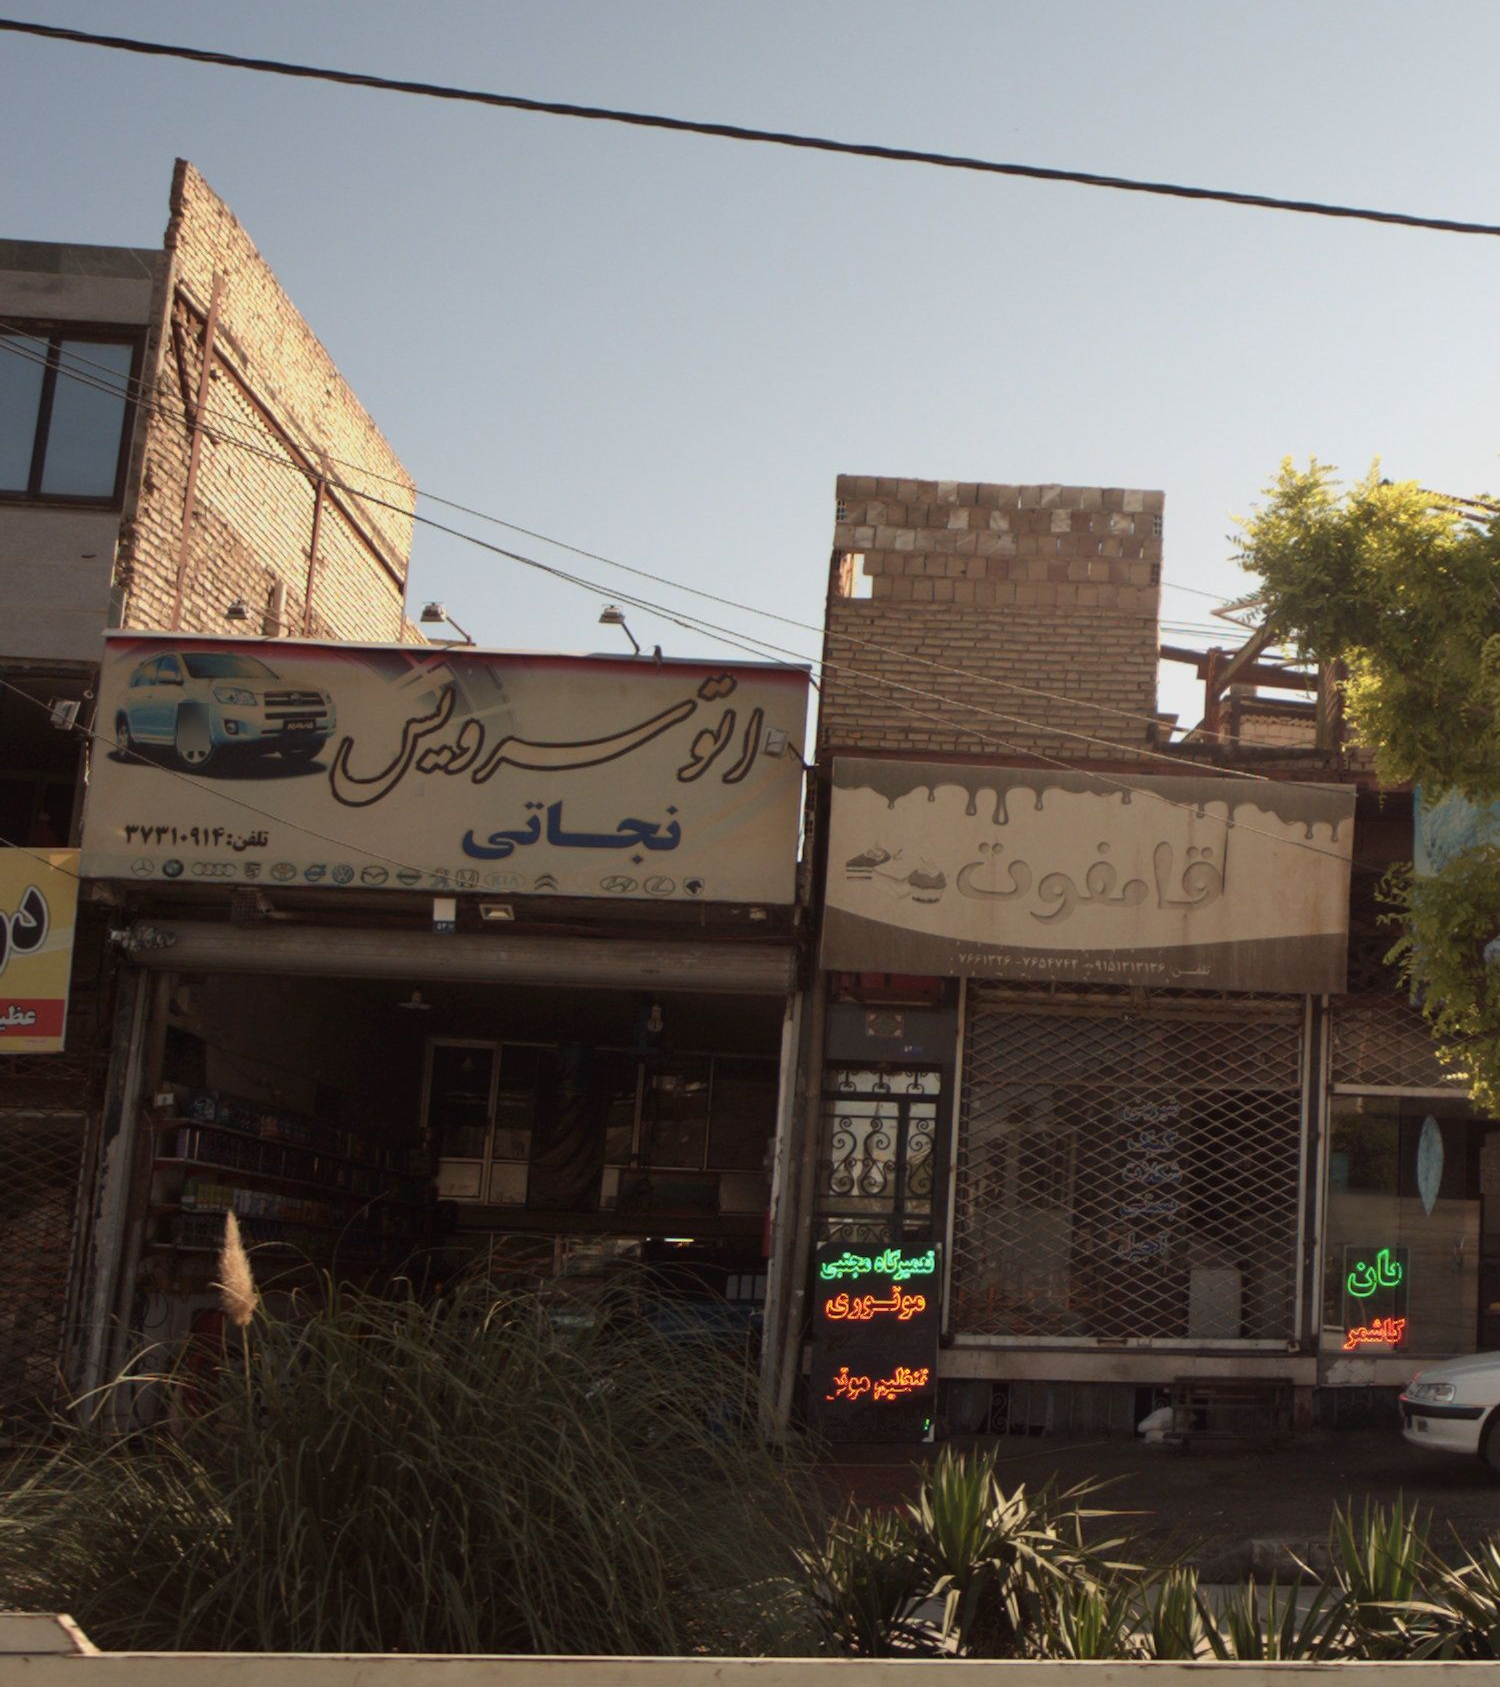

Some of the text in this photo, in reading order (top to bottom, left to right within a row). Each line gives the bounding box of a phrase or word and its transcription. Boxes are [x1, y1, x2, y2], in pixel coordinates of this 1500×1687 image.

[329, 672, 765, 807] اتو سرویس
[461, 800, 683, 866] نجاتی
[1347, 1248, 1403, 1298] نان
[825, 1285, 927, 1320] موتوری
[1343, 1318, 1406, 1350] کاشمر
